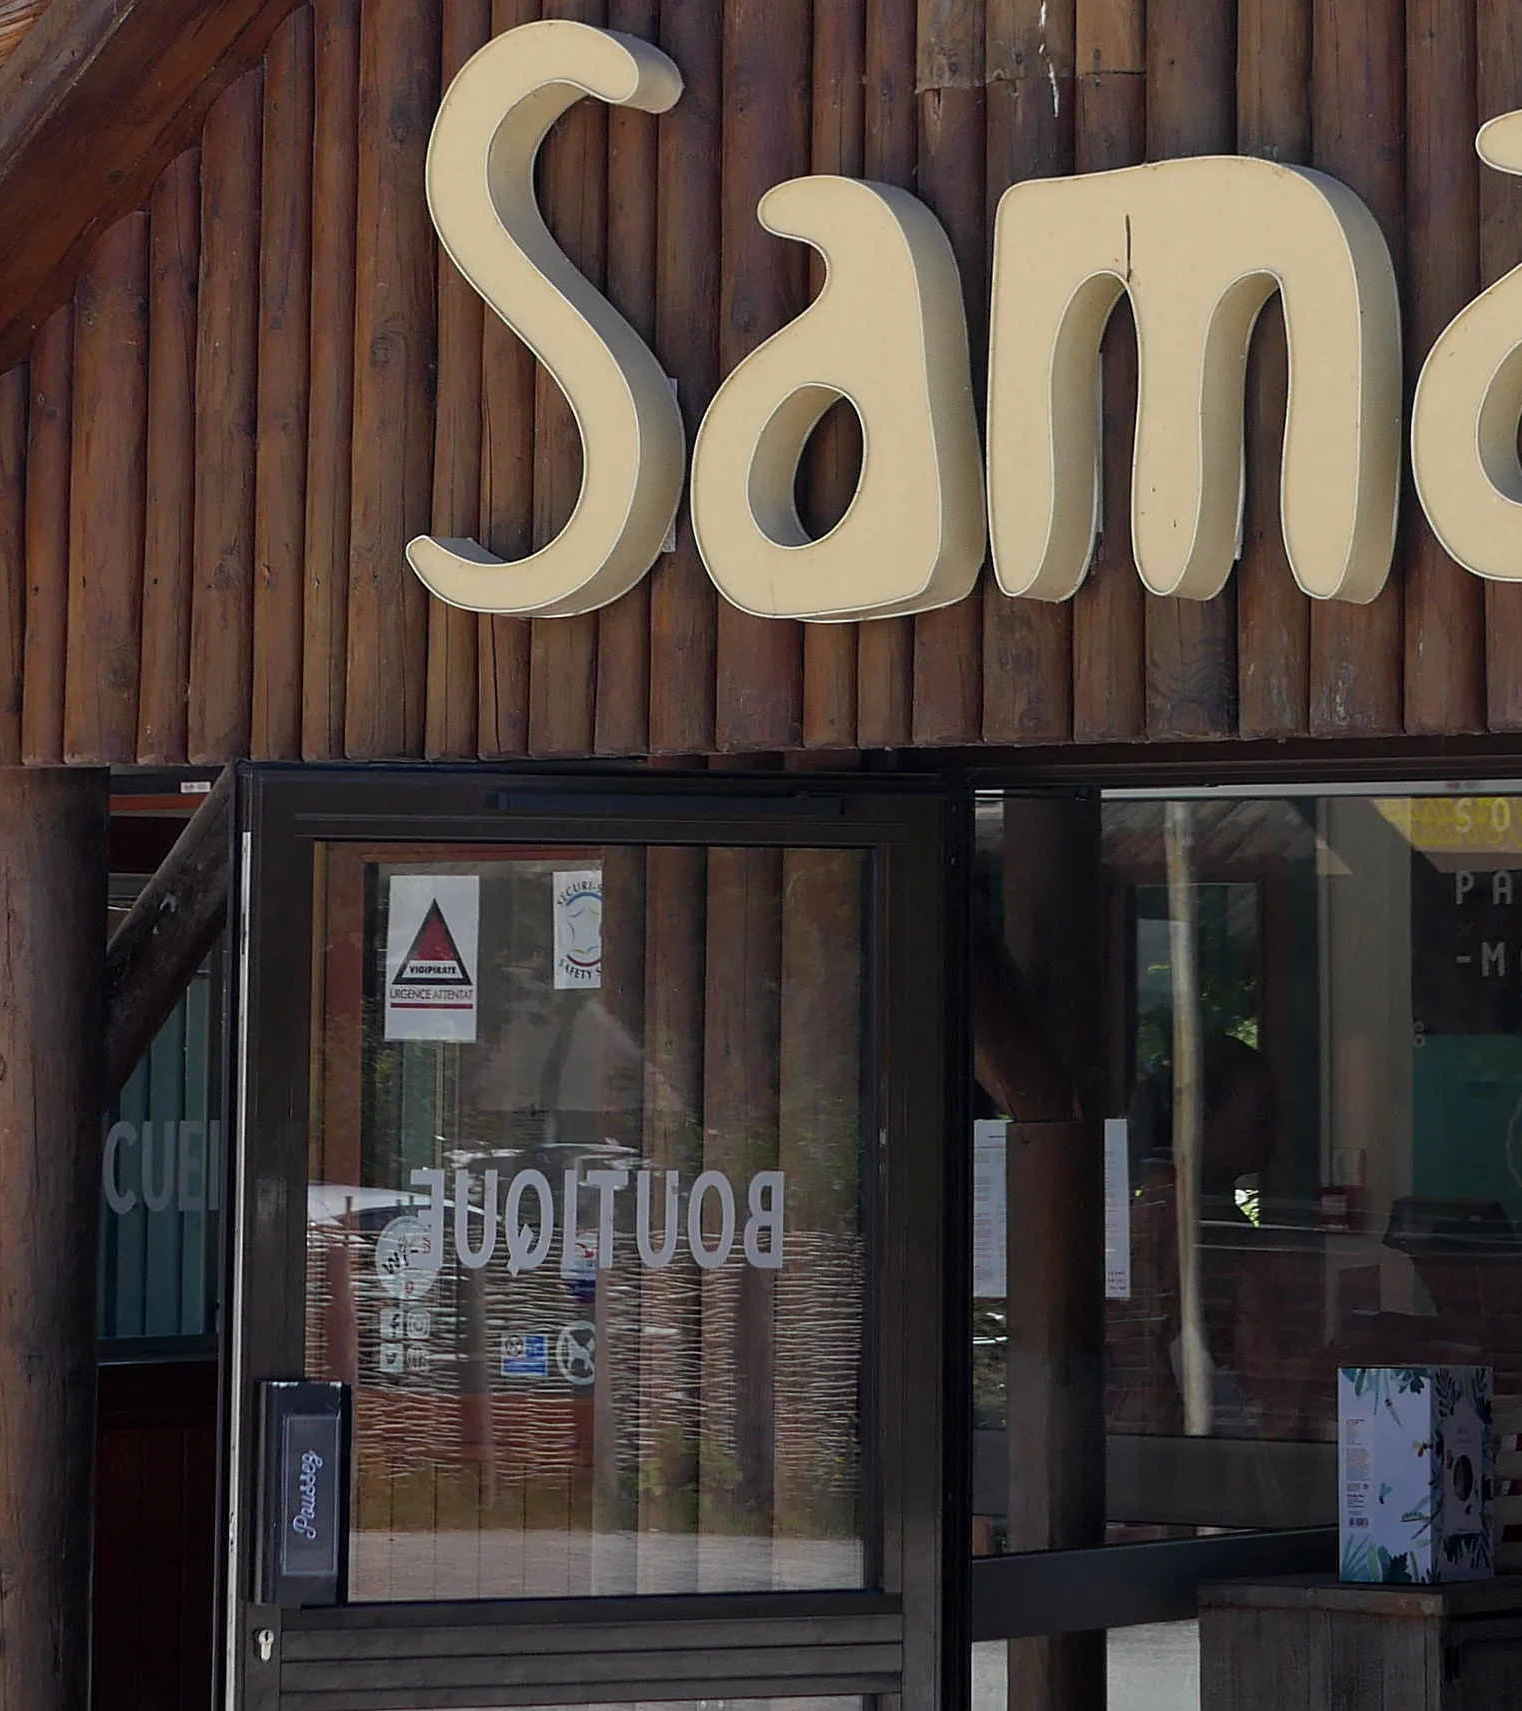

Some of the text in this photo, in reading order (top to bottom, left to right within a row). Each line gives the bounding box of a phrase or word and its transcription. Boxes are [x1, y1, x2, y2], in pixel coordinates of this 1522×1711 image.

[409, 965, 457, 975] VIGIPIRATE
[558, 957, 592, 979] SAFETY
[390, 989, 473, 1000] URGENCE ATTENTAT
[293, 1449, 323, 1540] Poussez
